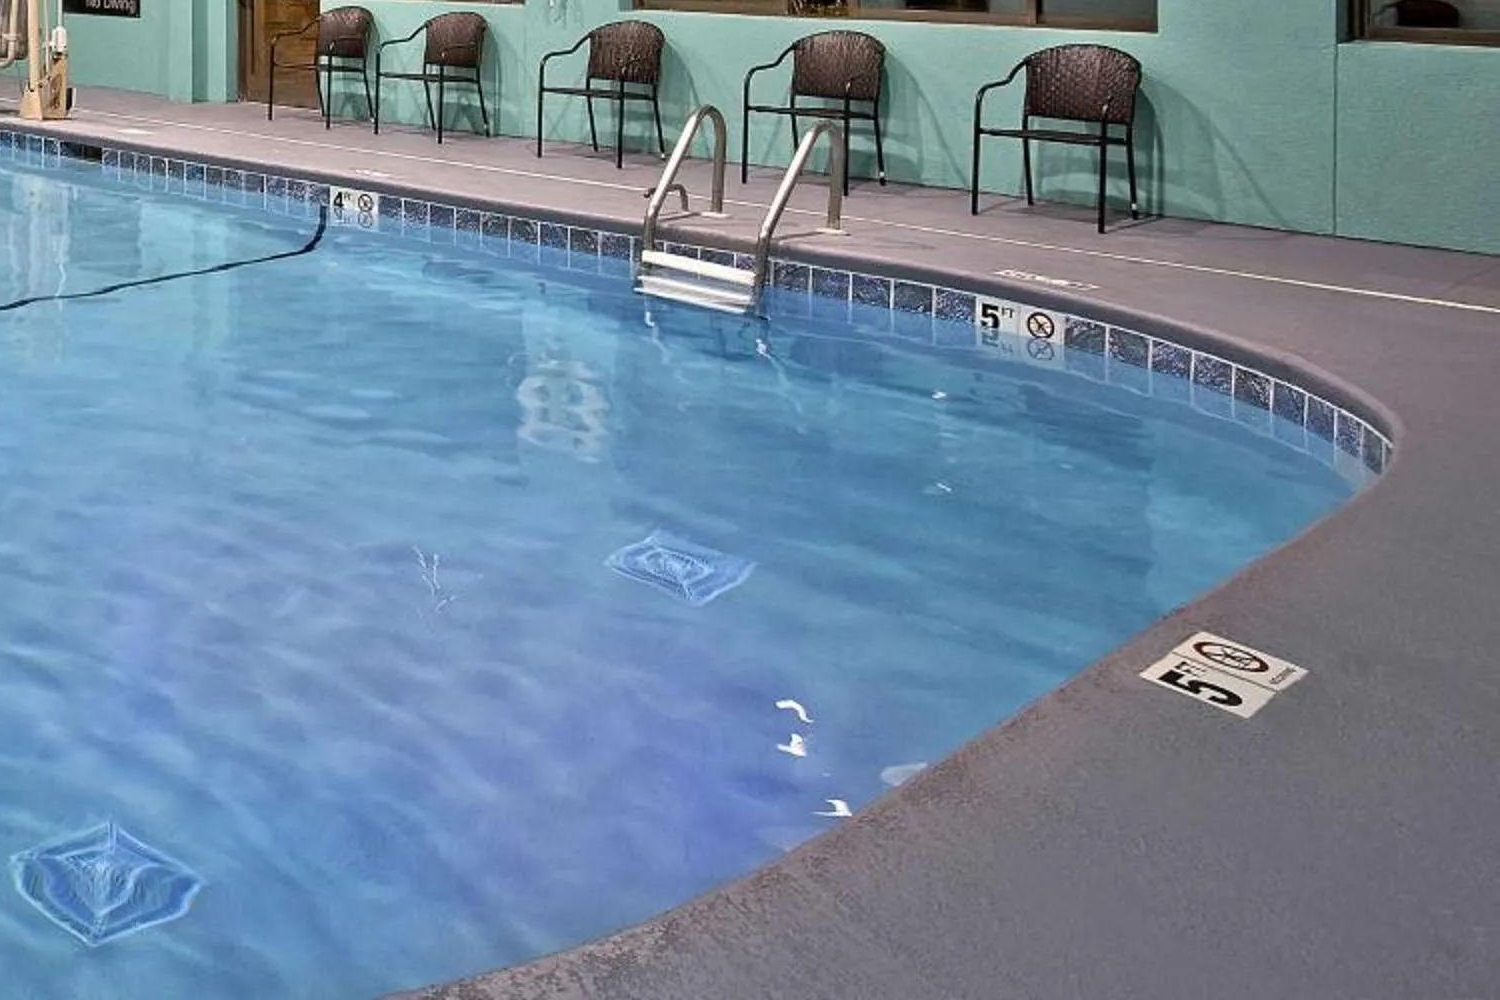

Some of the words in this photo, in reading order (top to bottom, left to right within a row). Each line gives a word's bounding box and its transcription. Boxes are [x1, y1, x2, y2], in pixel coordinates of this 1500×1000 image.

[334, 191, 344, 208] 4
[981, 303, 1000, 329] 5
[1158, 669, 1243, 707] 5
